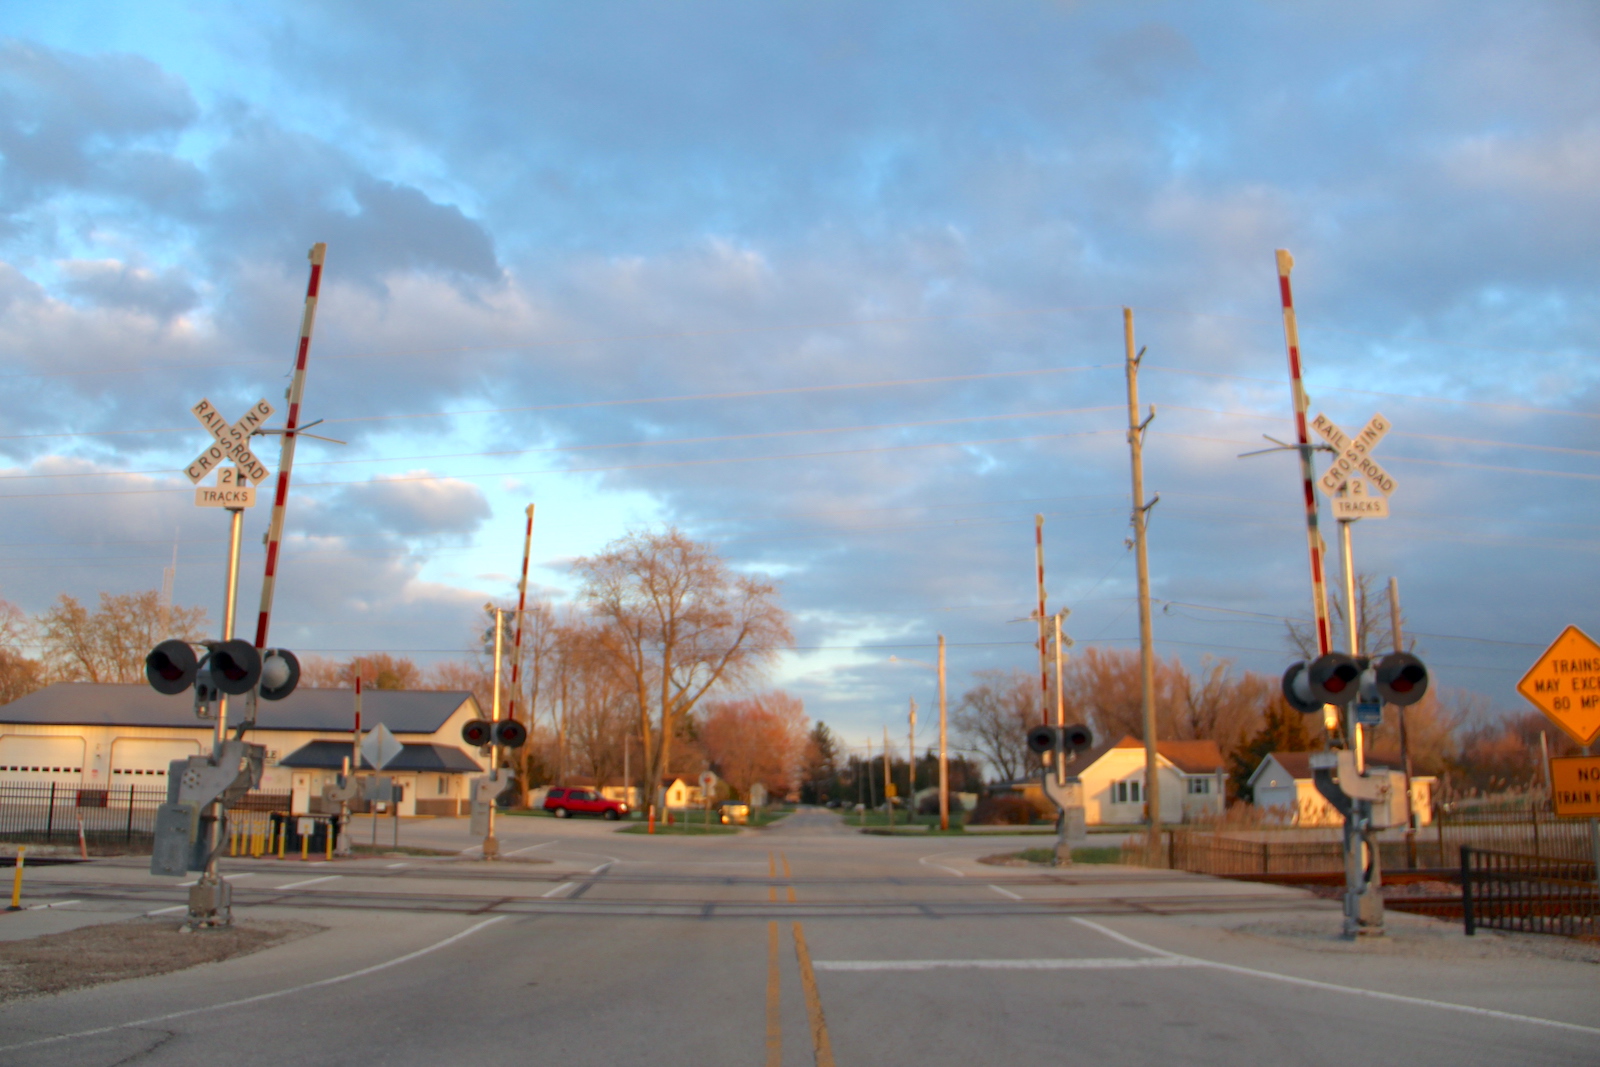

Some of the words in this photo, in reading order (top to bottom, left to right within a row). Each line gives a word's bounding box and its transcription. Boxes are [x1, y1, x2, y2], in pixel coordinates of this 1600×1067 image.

[188, 402, 270, 479] CROSSING
[1322, 418, 1384, 489] CROSSING
[222, 469, 232, 483] 2
[1352, 480, 1362, 495] 2
[203, 490, 249, 502] TRACKS
[1338, 501, 1381, 512] TRACKS
[1552, 658, 1600, 673] TRAINS
[1535, 678, 1560, 692] MAY
[1557, 790, 1591, 804] TRAIN
